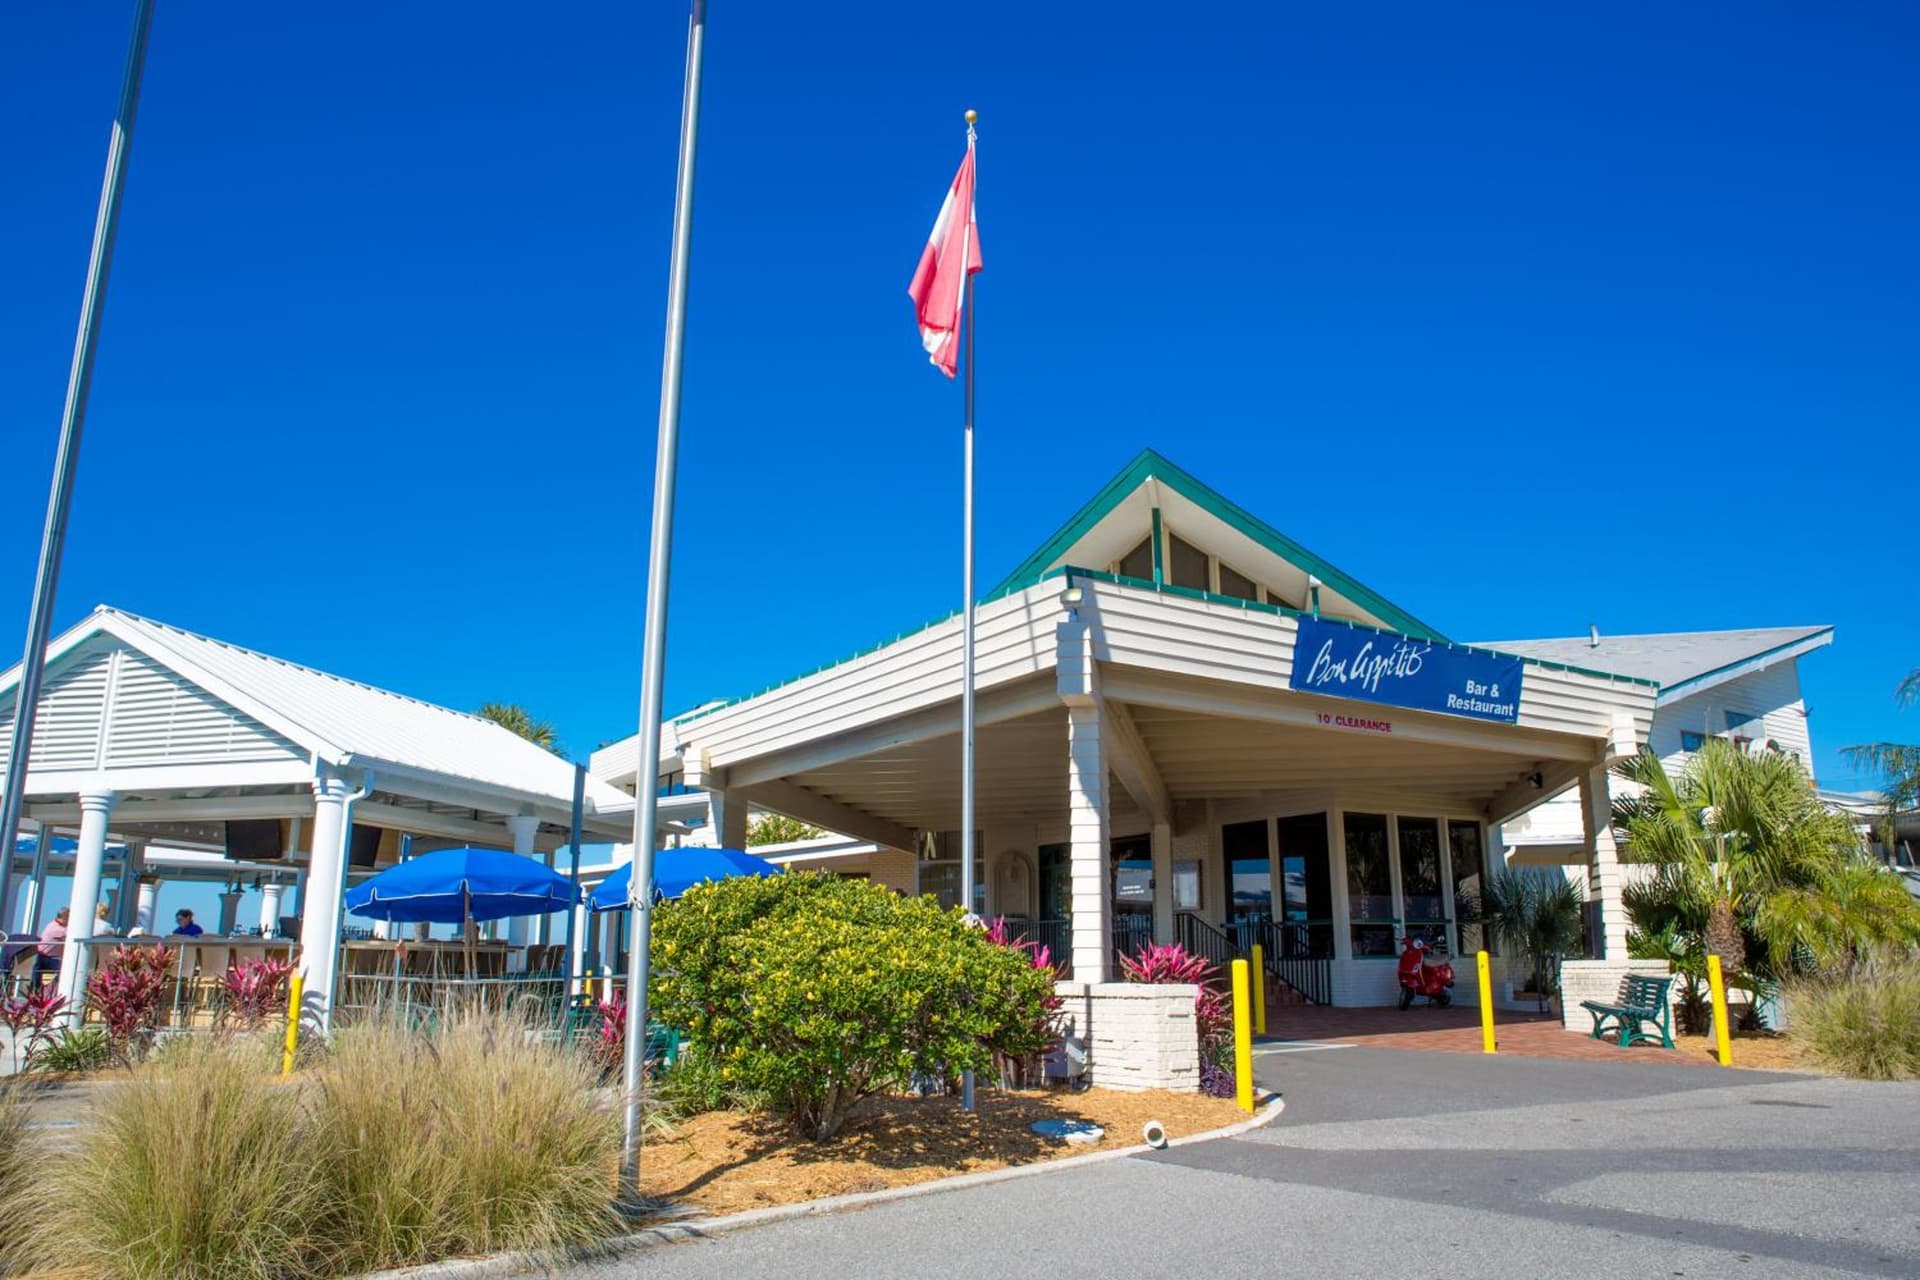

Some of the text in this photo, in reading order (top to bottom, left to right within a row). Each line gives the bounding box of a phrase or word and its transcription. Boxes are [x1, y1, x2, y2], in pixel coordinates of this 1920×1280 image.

[1306, 638, 1347, 686] Bon
[1465, 679, 1500, 698] Bar &
[1447, 693, 1514, 716] Restaurant
[1317, 713, 1392, 733] 10 CLEARANCE
